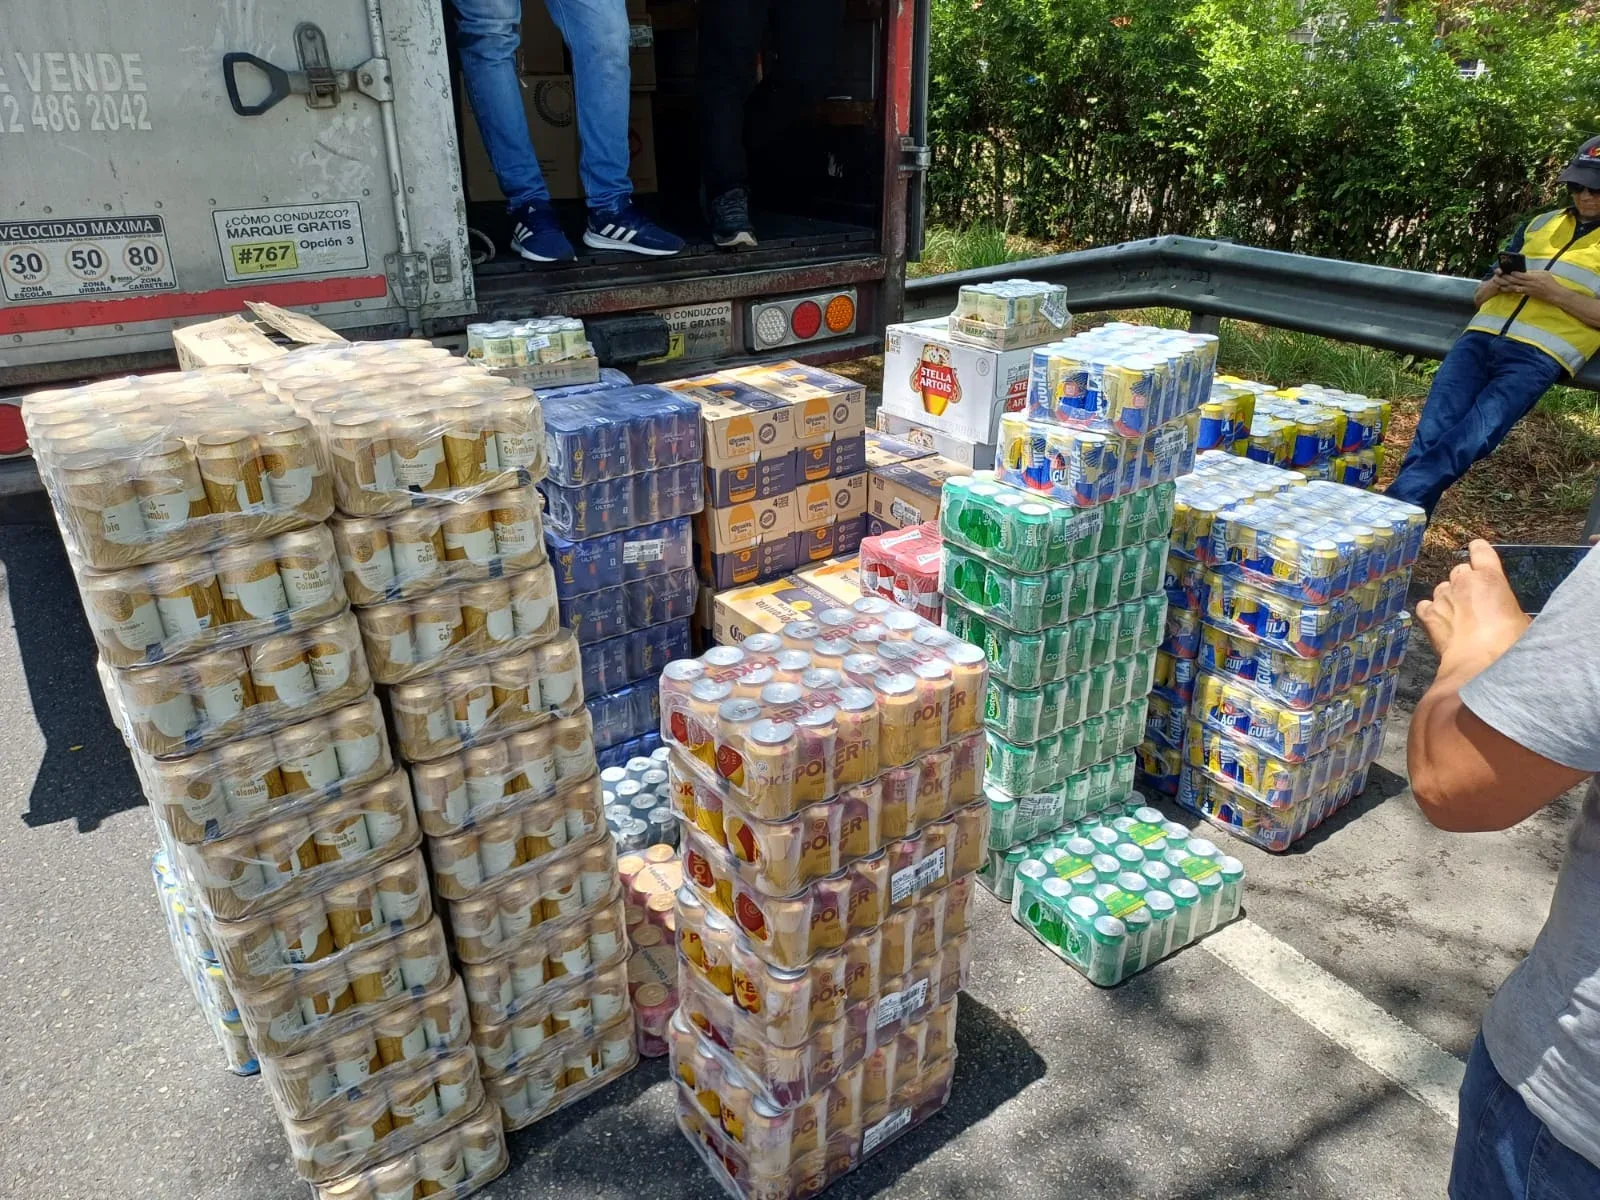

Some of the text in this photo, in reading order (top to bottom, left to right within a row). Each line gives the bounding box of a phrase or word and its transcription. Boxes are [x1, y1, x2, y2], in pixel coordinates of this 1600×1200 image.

[14, 52, 147, 92] VENDE
[31, 94, 81, 132] 486
[86, 94, 152, 131] 2042
[273, 209, 349, 223] CONDUZCO?
[91, 219, 154, 235] MAXIMA
[226, 219, 351, 239] MARQUE GRATIS
[299, 236, 354, 250] Opción 3
[71, 249, 103, 270] 50
[129, 245, 158, 266] 80
[238, 245, 290, 264] #767
[9, 252, 43, 274] 30
[78, 286, 112, 294] URBANA
[128, 281, 175, 290] CARRETERA
[14, 291, 53, 299] ESCOLAR
[673, 305, 729, 320] CONDUZCO?
[690, 317, 726, 329] GRATIS
[920, 366, 952, 383] STELLA
[919, 378, 952, 393] ARTOIS
[1013, 381, 1027, 392] STE
